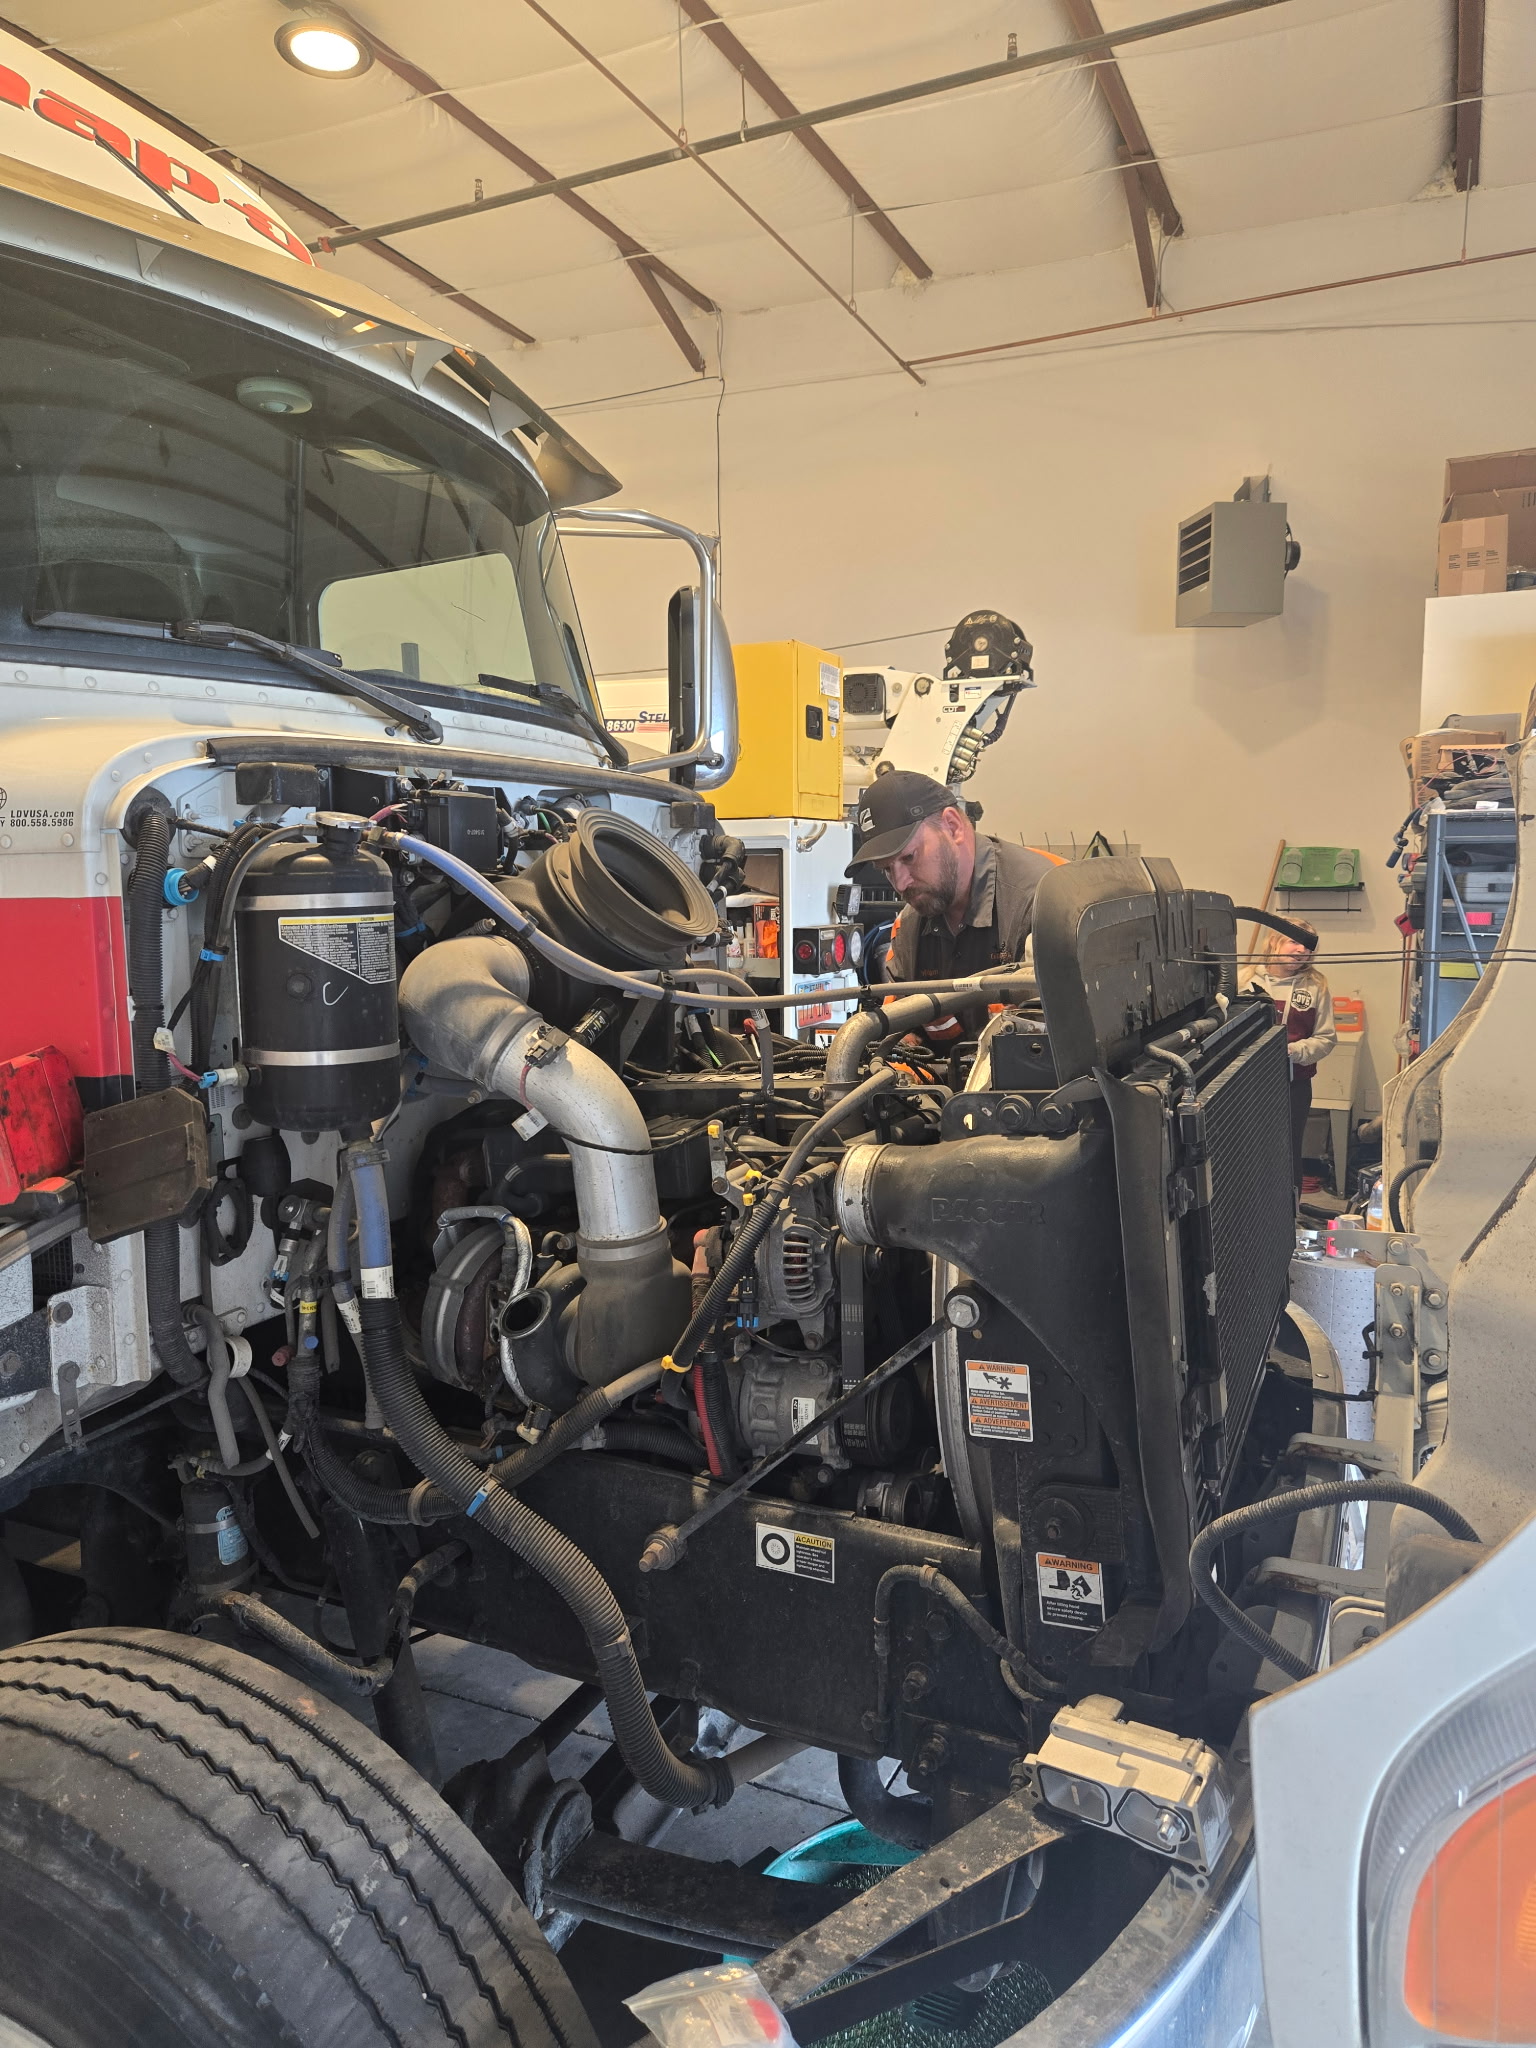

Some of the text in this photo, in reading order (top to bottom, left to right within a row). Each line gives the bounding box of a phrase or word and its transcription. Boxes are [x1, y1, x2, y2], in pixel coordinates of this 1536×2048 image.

[606, 720, 635, 732] 8630
[10, 809, 74, 818] LDVUSA.com
[10, 818, 74, 827] 800.558.5986
[1292, 993, 1310, 1006] LOVE
[987, 1364, 1016, 1373] WARNING
[980, 1398, 1027, 1409] AVERTISSEMENT
[984, 1417, 1026, 1427] ADVERTENCIA
[801, 1536, 832, 1548] CAUTION
[1052, 1559, 1093, 1571] WARNING
